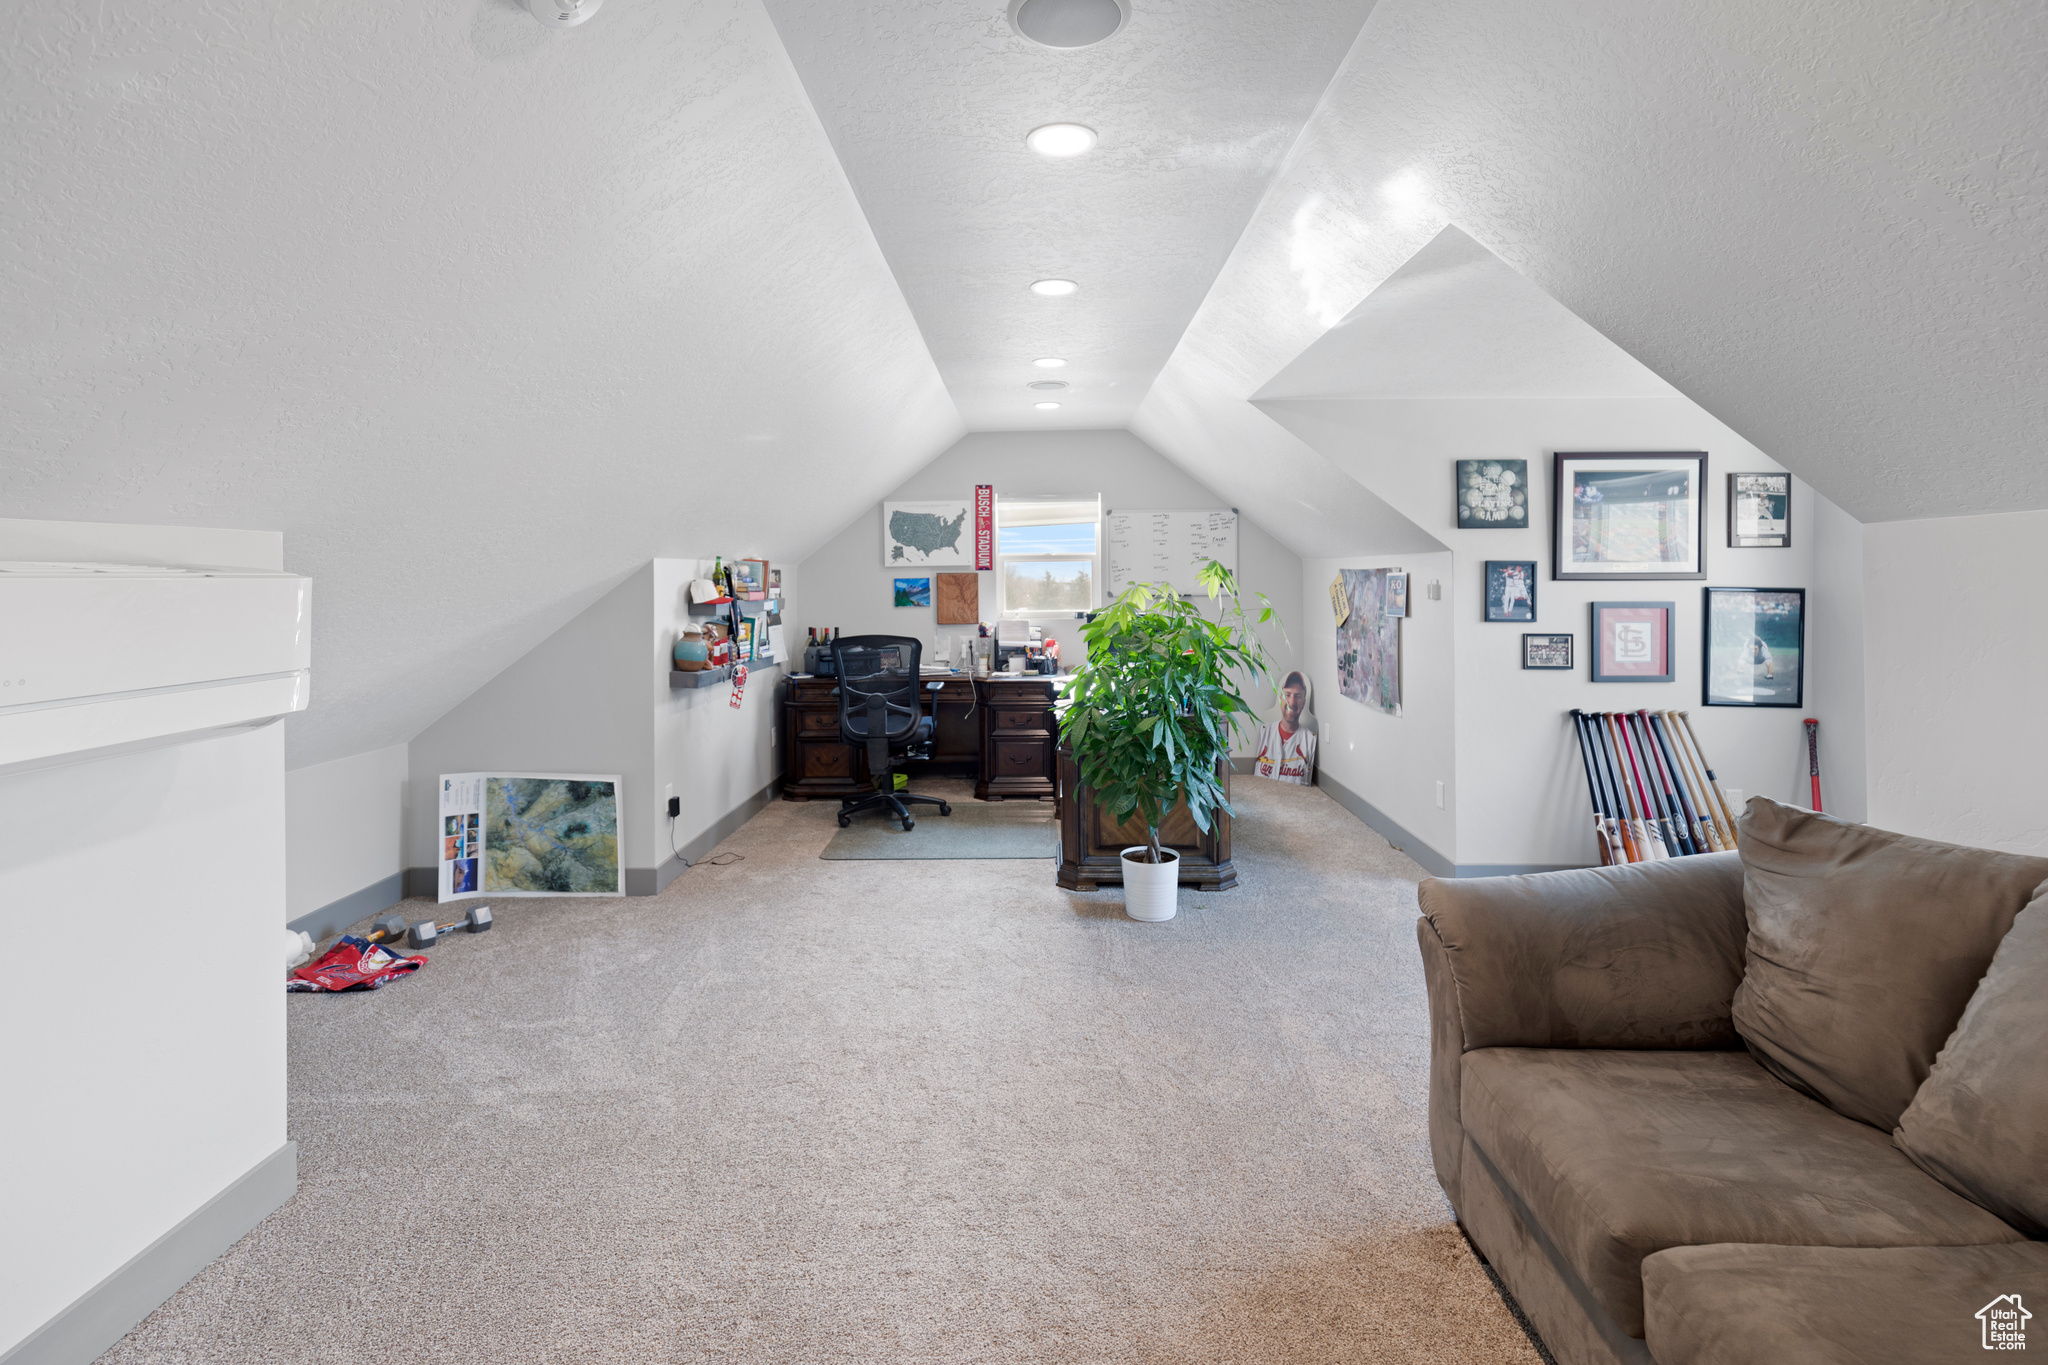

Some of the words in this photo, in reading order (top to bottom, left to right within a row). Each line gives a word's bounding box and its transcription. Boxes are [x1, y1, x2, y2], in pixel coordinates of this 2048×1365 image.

[1480, 483, 1505, 491] FEAR
[978, 489, 990, 517] BUSCH
[1480, 510, 1506, 522] GAME
[978, 530, 990, 567] STADIUM
[1260, 757, 1304, 776] Cardinals
